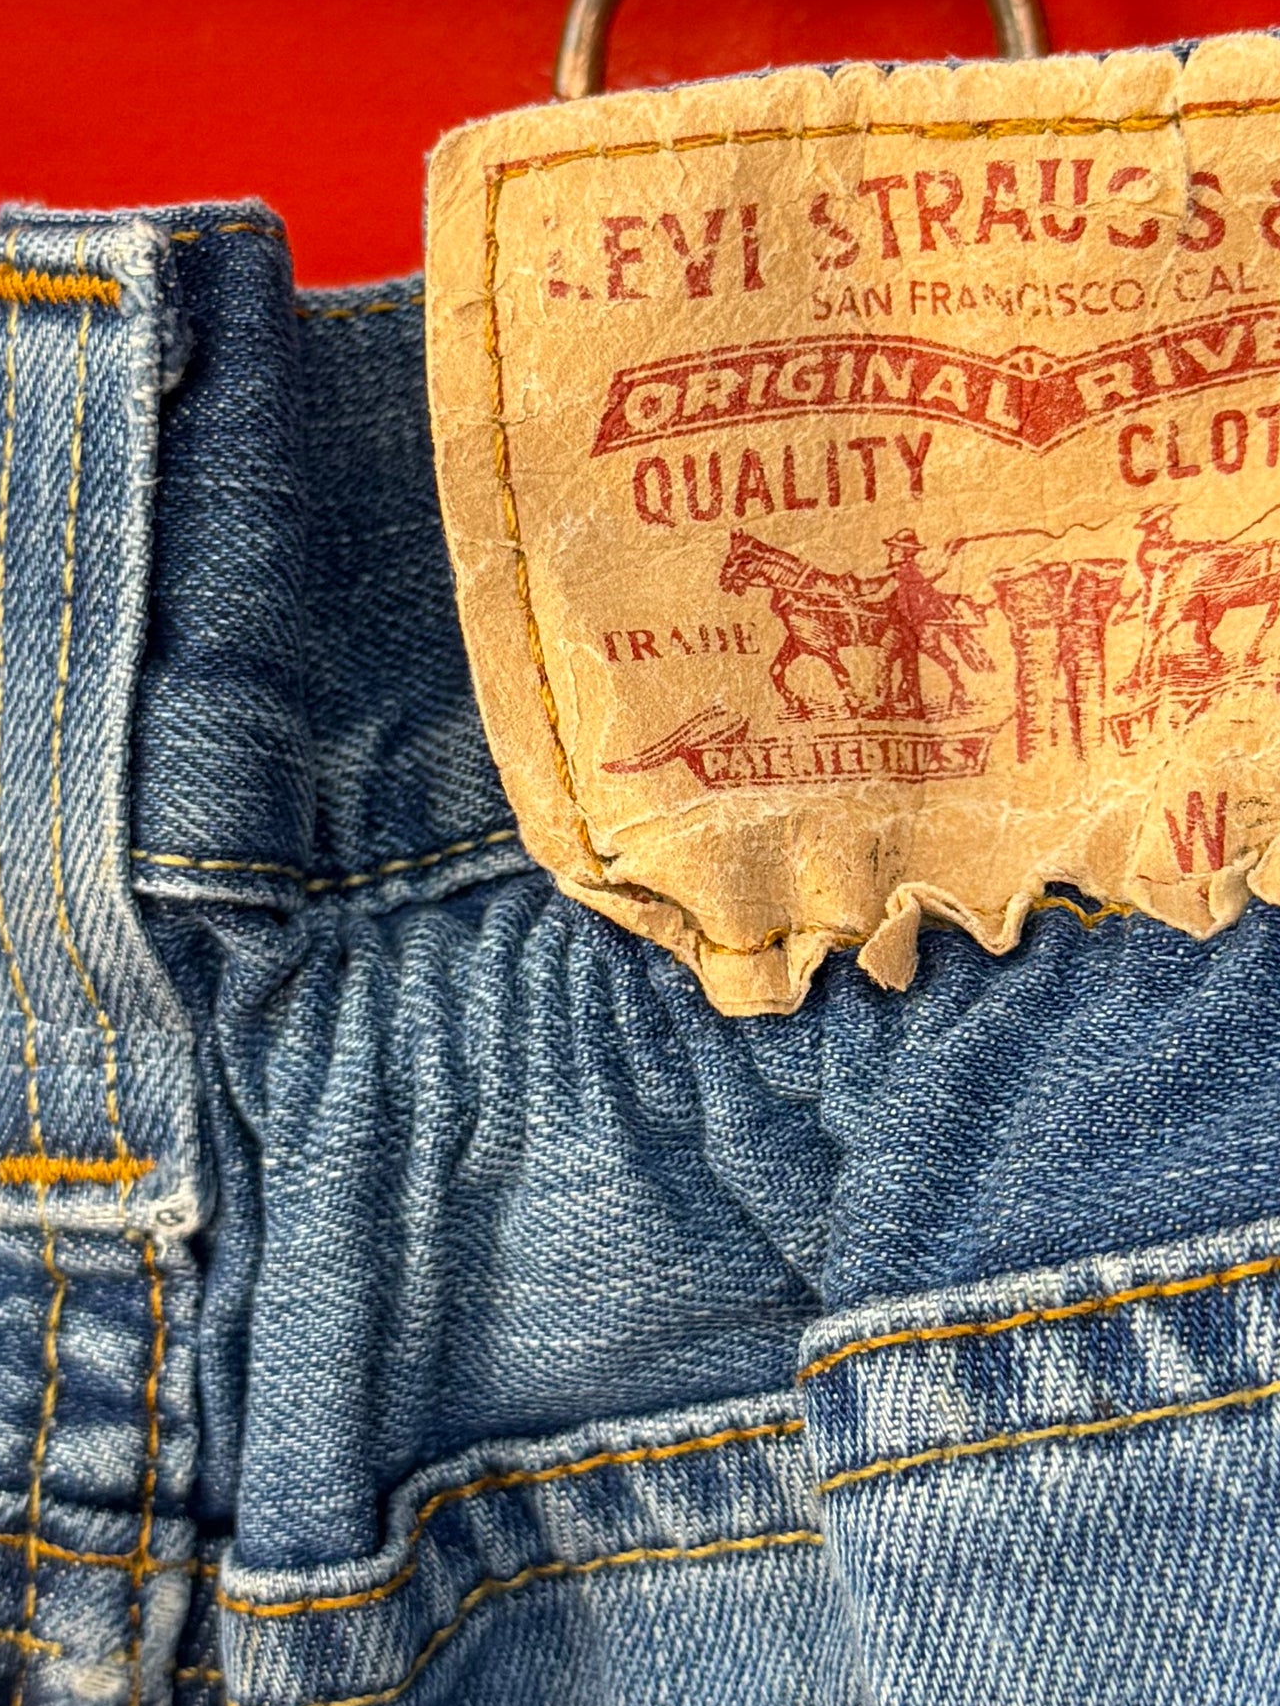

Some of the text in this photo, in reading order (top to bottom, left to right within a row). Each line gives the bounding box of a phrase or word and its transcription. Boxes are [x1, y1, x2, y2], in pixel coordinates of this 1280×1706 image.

[808, 159, 1226, 272] STRAUSS
[812, 282, 893, 323] SAN
[624, 351, 1021, 433] ORIGINAL
[632, 432, 933, 528] QUALITY
[602, 621, 761, 663] TRADE
